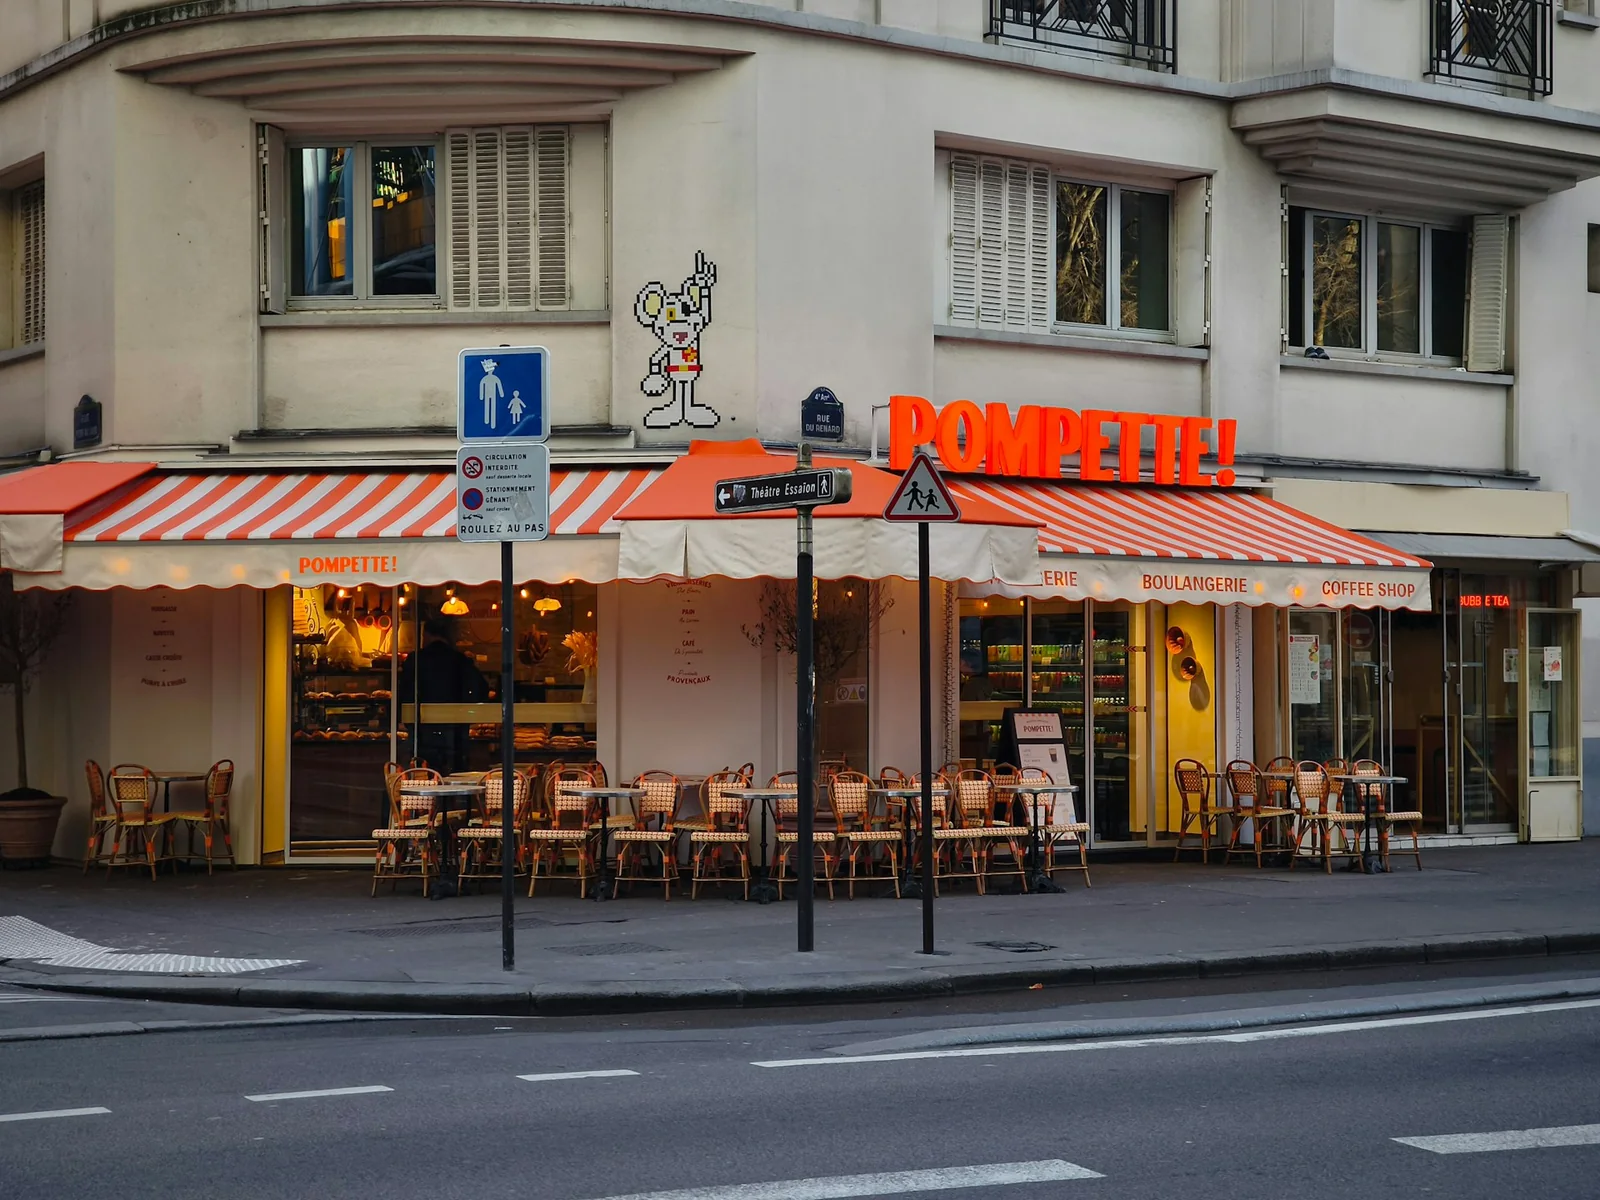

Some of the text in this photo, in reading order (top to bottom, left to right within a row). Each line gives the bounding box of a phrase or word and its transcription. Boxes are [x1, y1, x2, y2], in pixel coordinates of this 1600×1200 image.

[816, 414, 830, 423] RUE
[805, 423, 841, 434] DU RENARD
[889, 395, 1237, 487] POMPETTE!
[485, 453, 527, 461] CIRCULATION
[485, 485, 536, 493] STATIONNEMENT
[751, 481, 816, 499] Théâtre Essaïon
[485, 496, 510, 504] GÊNANT
[460, 523, 545, 534] ROULEZ AU PAS
[299, 556, 397, 574] POMPETTE!
[1142, 574, 1248, 593] BOULANGERIE
[1322, 580, 1374, 597] COFFEE
[1378, 582, 1415, 598] SHOP
[1491, 595, 1510, 606] TEA
